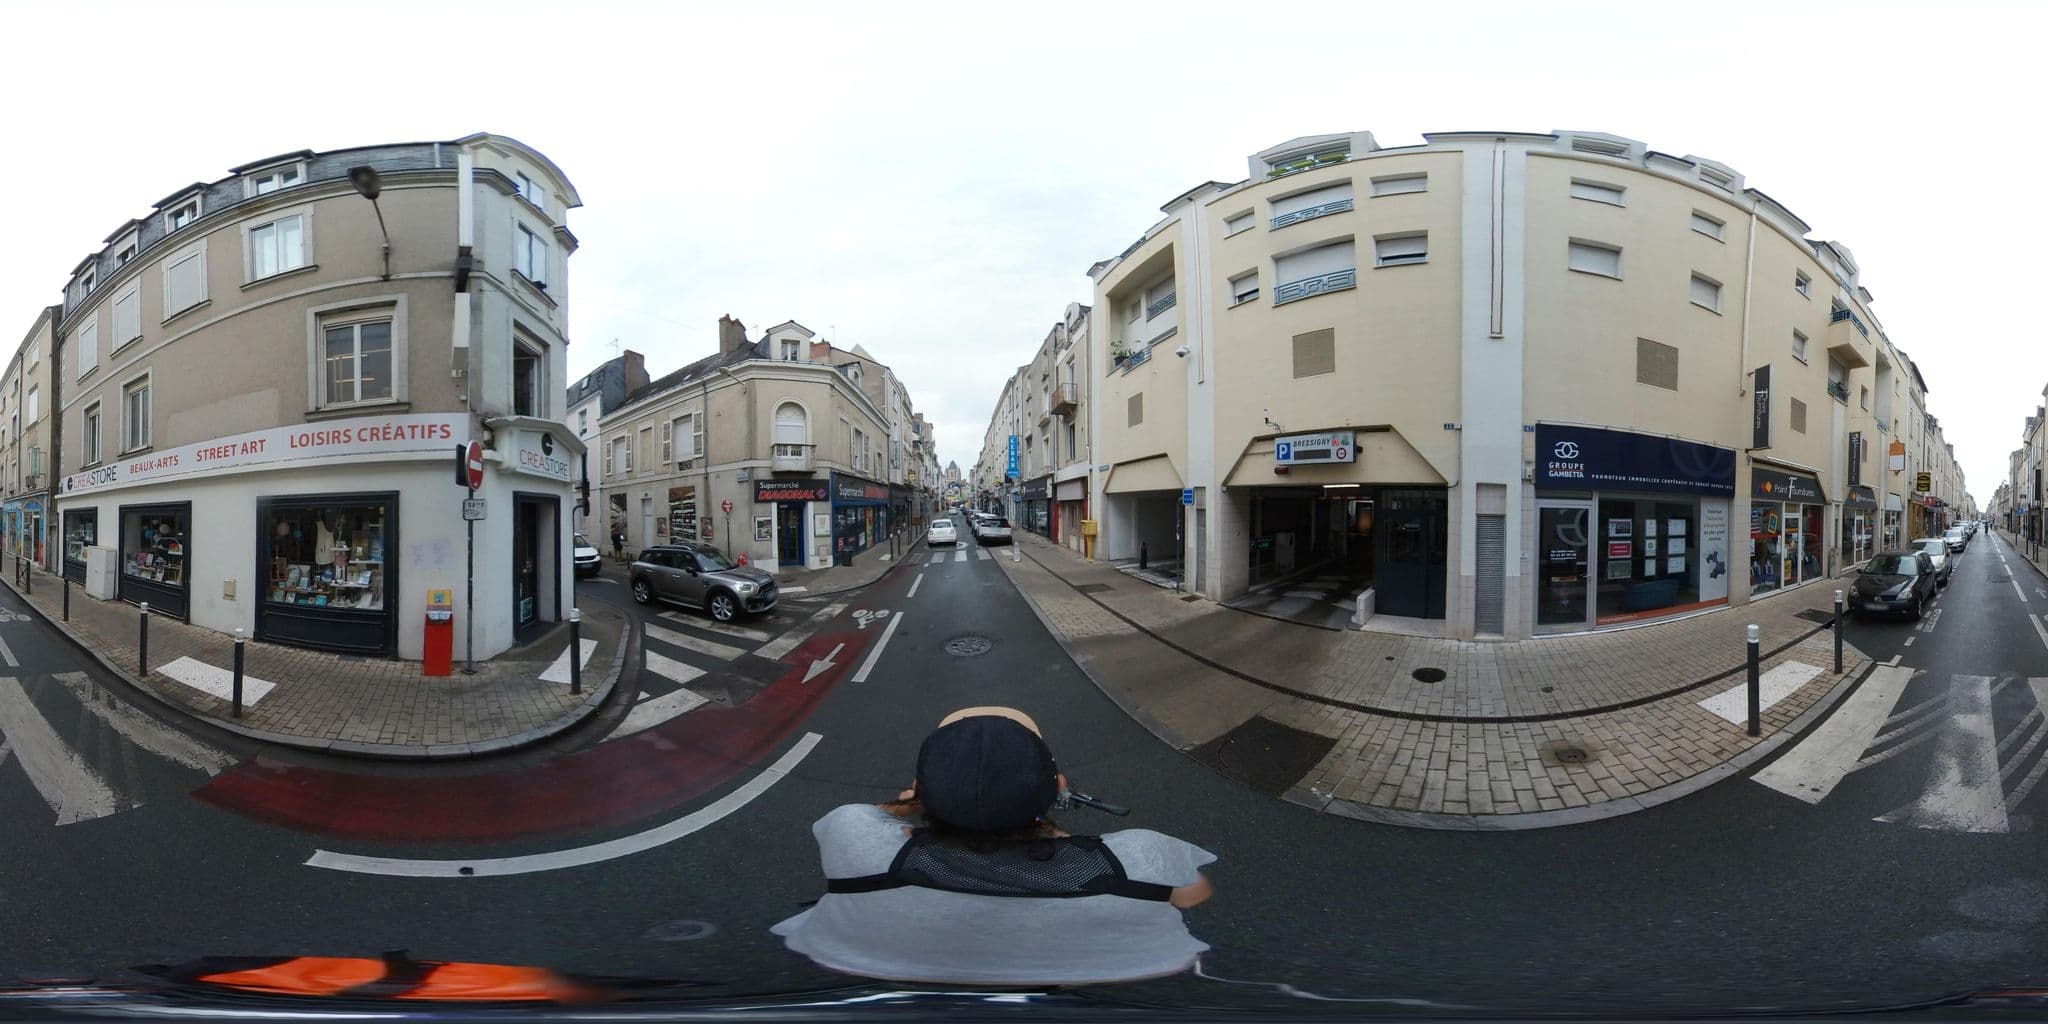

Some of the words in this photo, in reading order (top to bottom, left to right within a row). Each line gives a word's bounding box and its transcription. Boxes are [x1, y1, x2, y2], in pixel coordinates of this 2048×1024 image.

[290, 429, 352, 449] LOISIRS
[357, 422, 452, 442] CRÉATIFS
[1293, 438, 1331, 447] BRESSIGNY
[196, 444, 238, 463] STREET
[240, 439, 267, 455] ART
[130, 454, 180, 474] BEAUX-ARTS
[519, 448, 569, 477] CREASTORE
[1548, 461, 1585, 470] GROUPE
[1548, 470, 1585, 479] GAMBETTA
[1591, 473, 1626, 481] PROMOTEUR
[759, 481, 800, 490] Supermarché
[1774, 484, 1788, 494] Point
